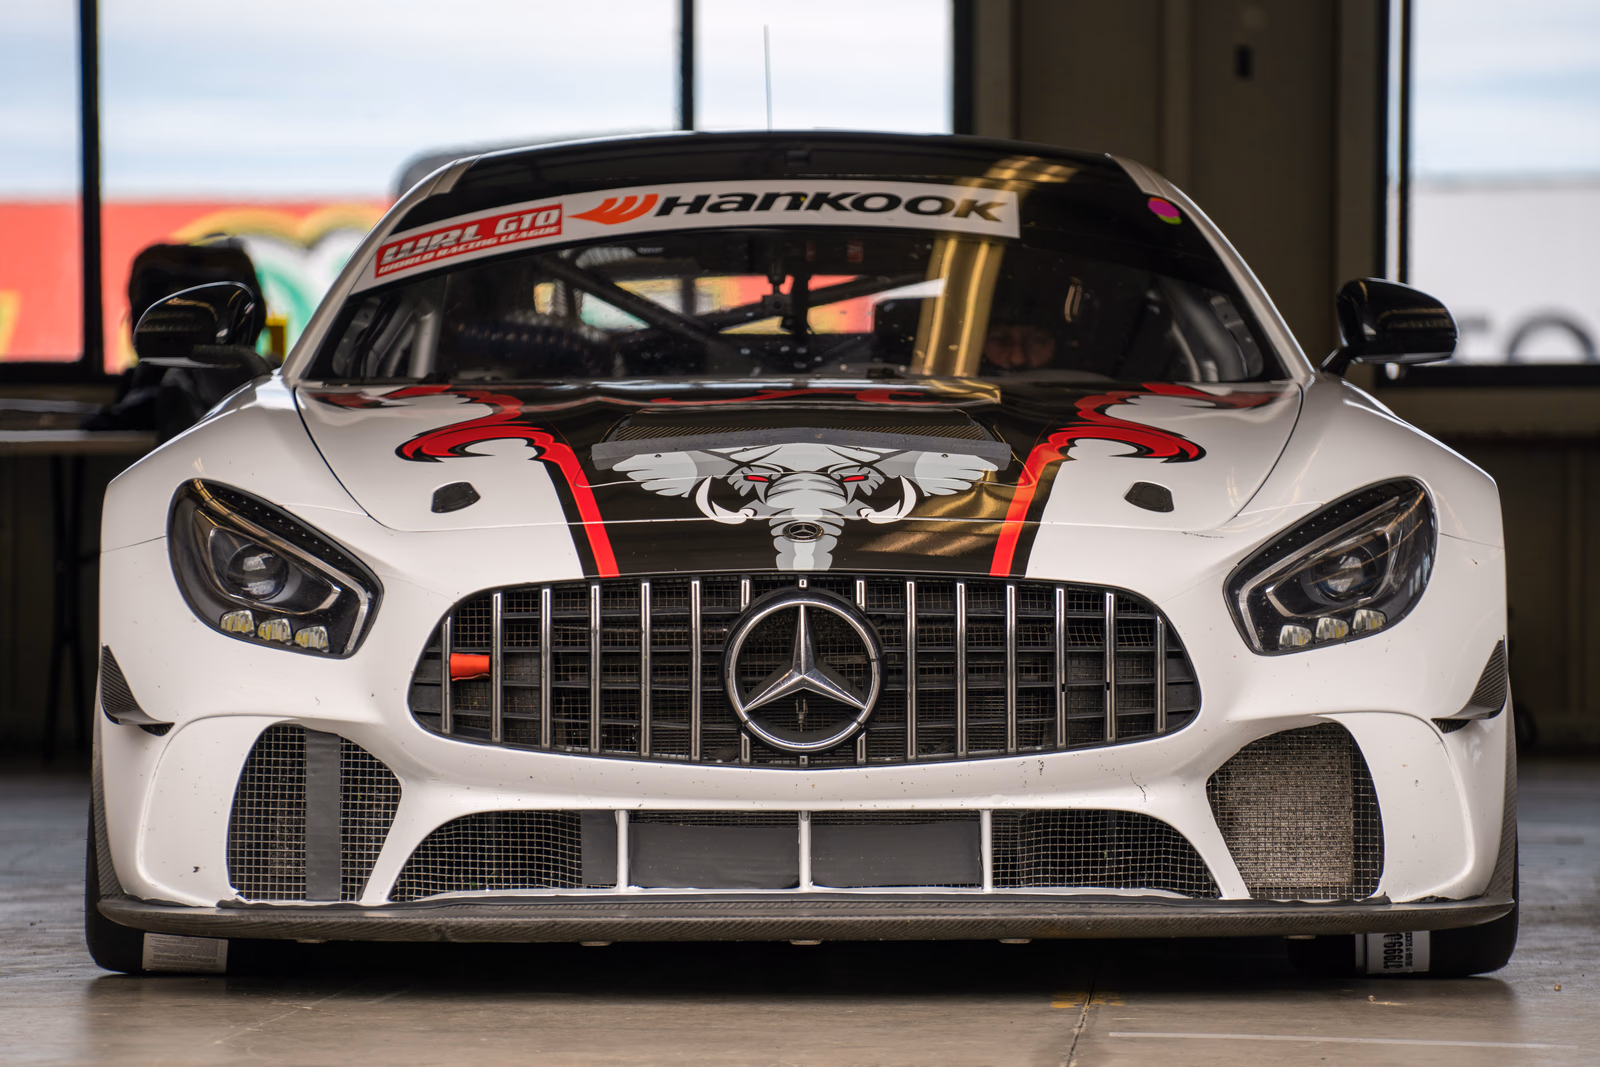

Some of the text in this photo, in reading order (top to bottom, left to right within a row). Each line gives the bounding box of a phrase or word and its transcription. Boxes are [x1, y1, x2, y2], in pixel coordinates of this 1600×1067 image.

[377, 251, 436, 275] WORLD
[499, 225, 561, 243] LEAGUE
[380, 208, 561, 265] WRL GTO
